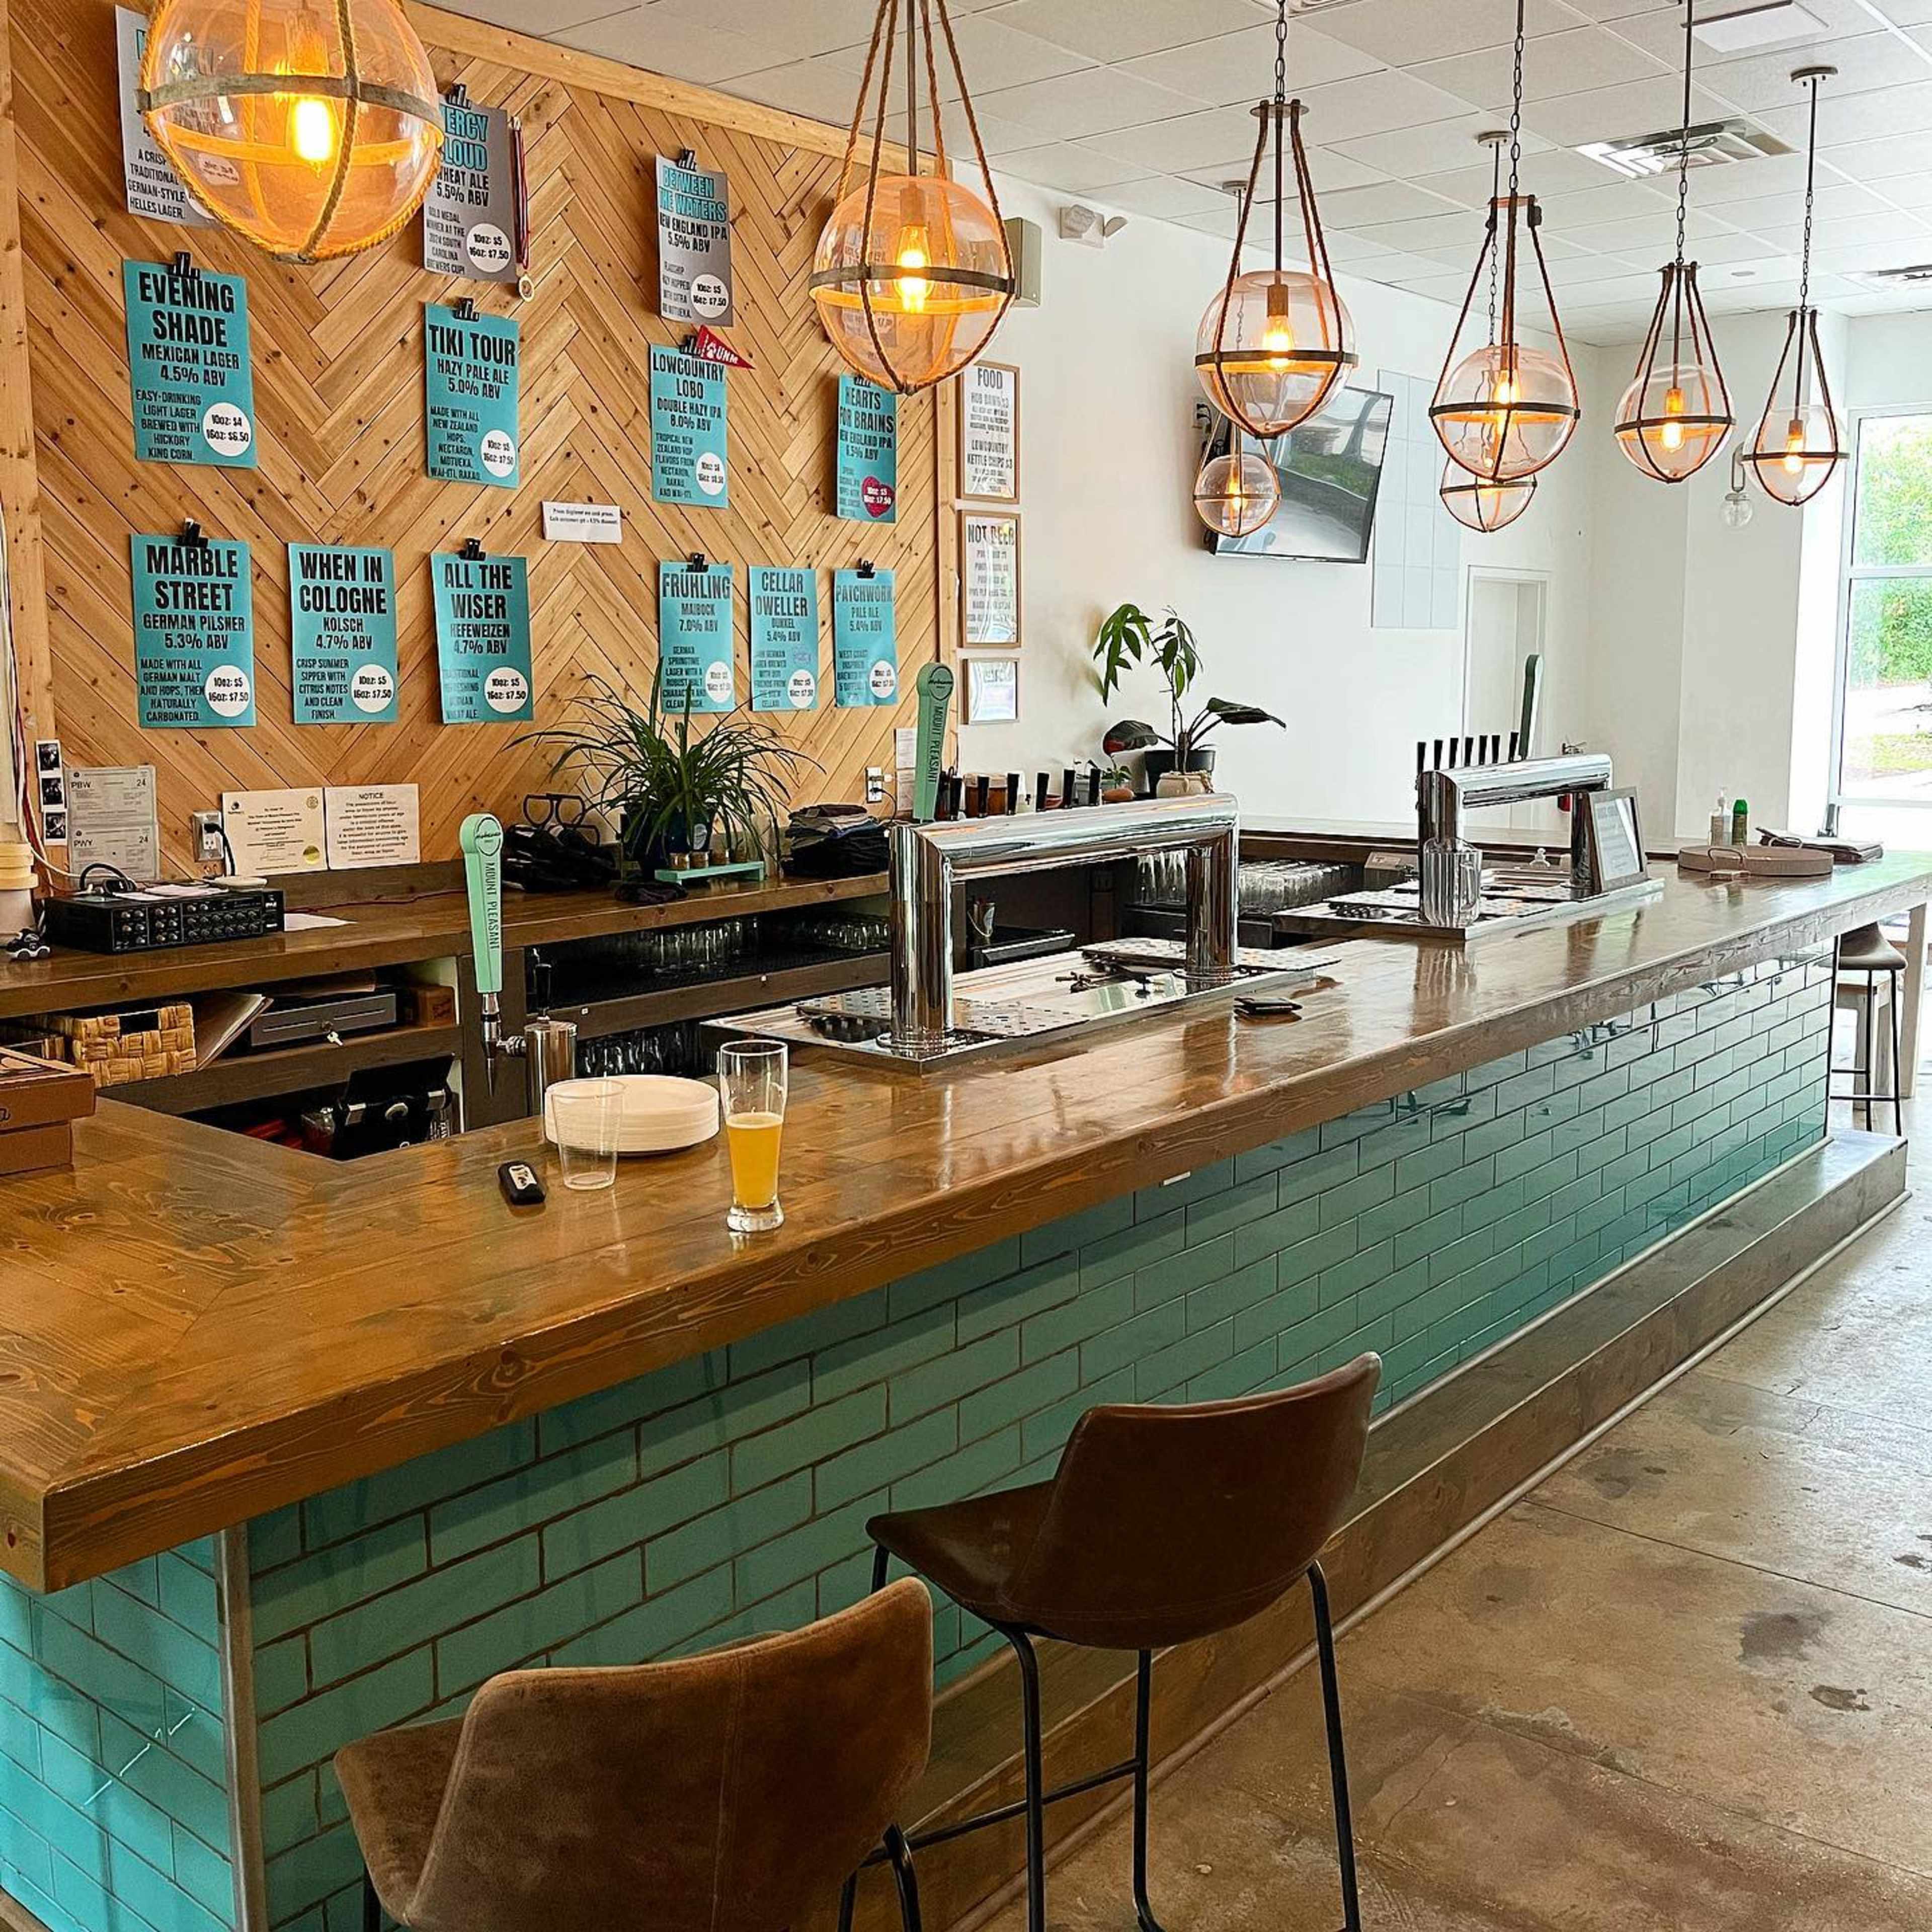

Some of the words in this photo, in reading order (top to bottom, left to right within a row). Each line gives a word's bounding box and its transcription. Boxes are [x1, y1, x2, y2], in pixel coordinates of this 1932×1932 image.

[138, 149, 143, 160] A
[470, 173, 489, 190] ALE
[663, 166, 714, 198] BETWEEN
[128, 179, 185, 203] GERMAN-STYLE
[437, 182, 464, 203] 5.5%
[468, 189, 489, 207] ABV
[130, 196, 157, 213] HELLES
[675, 193, 727, 222] WATERS
[672, 217, 708, 237] ENGLAND
[711, 225, 727, 240] IPA
[494, 236, 502, 246] $5
[668, 232, 690, 250] 5.5%
[693, 237, 710, 253] ABV
[489, 250, 509, 260] $7.50
[139, 271, 234, 313] EVENING
[152, 310, 227, 347] SHADE
[429, 324, 463, 357] TIKI
[469, 333, 516, 367] TOUR
[141, 343, 199, 364] MEXICAN
[203, 352, 239, 369] LAGER
[437, 358, 463, 377] HAZY
[466, 363, 490, 381] PALE
[493, 369, 509, 385] ALE
[653, 353, 724, 382] LOWCOUNTRY
[160, 366, 199, 383] 4.5%
[203, 371, 226, 387] ABV
[978, 367, 1003, 389] FOOD
[449, 378, 479, 396] 5.0%
[482, 384, 500, 400] ABV
[676, 378, 703, 399] LOBO
[136, 390, 201, 406] EASY-DRINKING
[845, 386, 880, 410] HEARTS
[143, 405, 168, 416] LIGHT
[170, 408, 196, 419] LAGER
[451, 409, 467, 419] WITH
[469, 411, 479, 422] ALL
[657, 397, 687, 414] DOUBLE
[689, 402, 708, 417] HAZY
[141, 419, 176, 431] BREWED
[179, 422, 200, 433] WITH
[233, 417, 242, 427] $4
[433, 418, 448, 429] NEW
[450, 420, 478, 433] ZEALAND
[670, 414, 695, 429] 8.0%
[696, 418, 711, 431] ABV
[854, 411, 894, 434] BRAINS
[154, 433, 190, 446] HICKORY
[228, 432, 249, 442] $6.50
[148, 448, 168, 458] KING
[968, 453, 987, 466] KETTLE
[968, 524, 987, 543] NOT
[146, 544, 238, 578] MARBLE
[299, 552, 357, 582] WHEN
[363, 555, 383, 583] IN
[444, 563, 474, 589] ALL
[478, 564, 513, 590] THE
[762, 571, 803, 593] CELLAR
[154, 580, 233, 611] STREET
[300, 585, 387, 614] COLOGNE
[836, 585, 893, 602] PATCHWORK
[451, 593, 507, 619] WISER
[755, 595, 808, 617] DWELLER
[851, 607, 867, 618] PALE
[143, 613, 195, 631] GERMAN
[200, 615, 245, 632] PILSNER
[324, 617, 364, 632] KOLSCH
[451, 624, 510, 637] HEFEWEIZEN
[679, 619, 702, 631] 7.0%
[165, 633, 202, 649] 5.3%
[206, 634, 229, 650] ABV
[316, 634, 349, 650] 4.7%
[352, 635, 372, 650] ABV
[767, 630, 786, 641] 5.4%
[454, 640, 484, 654] 4.7%
[487, 640, 507, 654] ABV
[141, 659, 164, 669] MADE
[166, 660, 186, 669] WITH
[188, 660, 202, 669] ALL
[296, 658, 317, 668] CRISP
[318, 659, 349, 668] SUMMER
[143, 672, 178, 682] GERMAN
[180, 672, 200, 682] MALT
[234, 677, 243, 687] $5
[301, 672, 326, 681] SIPPER
[327, 672, 345, 681] WITH
[378, 676, 386, 684] $5
[511, 678, 520, 686] $5
[140, 686, 157, 695] AND
[159, 686, 183, 696] HOPS,
[185, 686, 206, 695] THEN
[229, 692, 249, 702] $7.50
[299, 684, 324, 694] CITRUS
[326, 684, 348, 694] NOTES
[372, 689, 392, 698] $7.50
[506, 691, 526, 700] $7.50
[151, 699, 196, 709] NATURALLY
[304, 697, 319, 706] AND
[320, 697, 343, 706] CLEAN
[928, 740, 940, 782] PLEASANT
[136, 779, 146, 787] 24
[359, 792, 384, 800] NOTICE
[485, 862, 497, 895] MOUNT
[488, 902, 500, 949] PLEASANT
